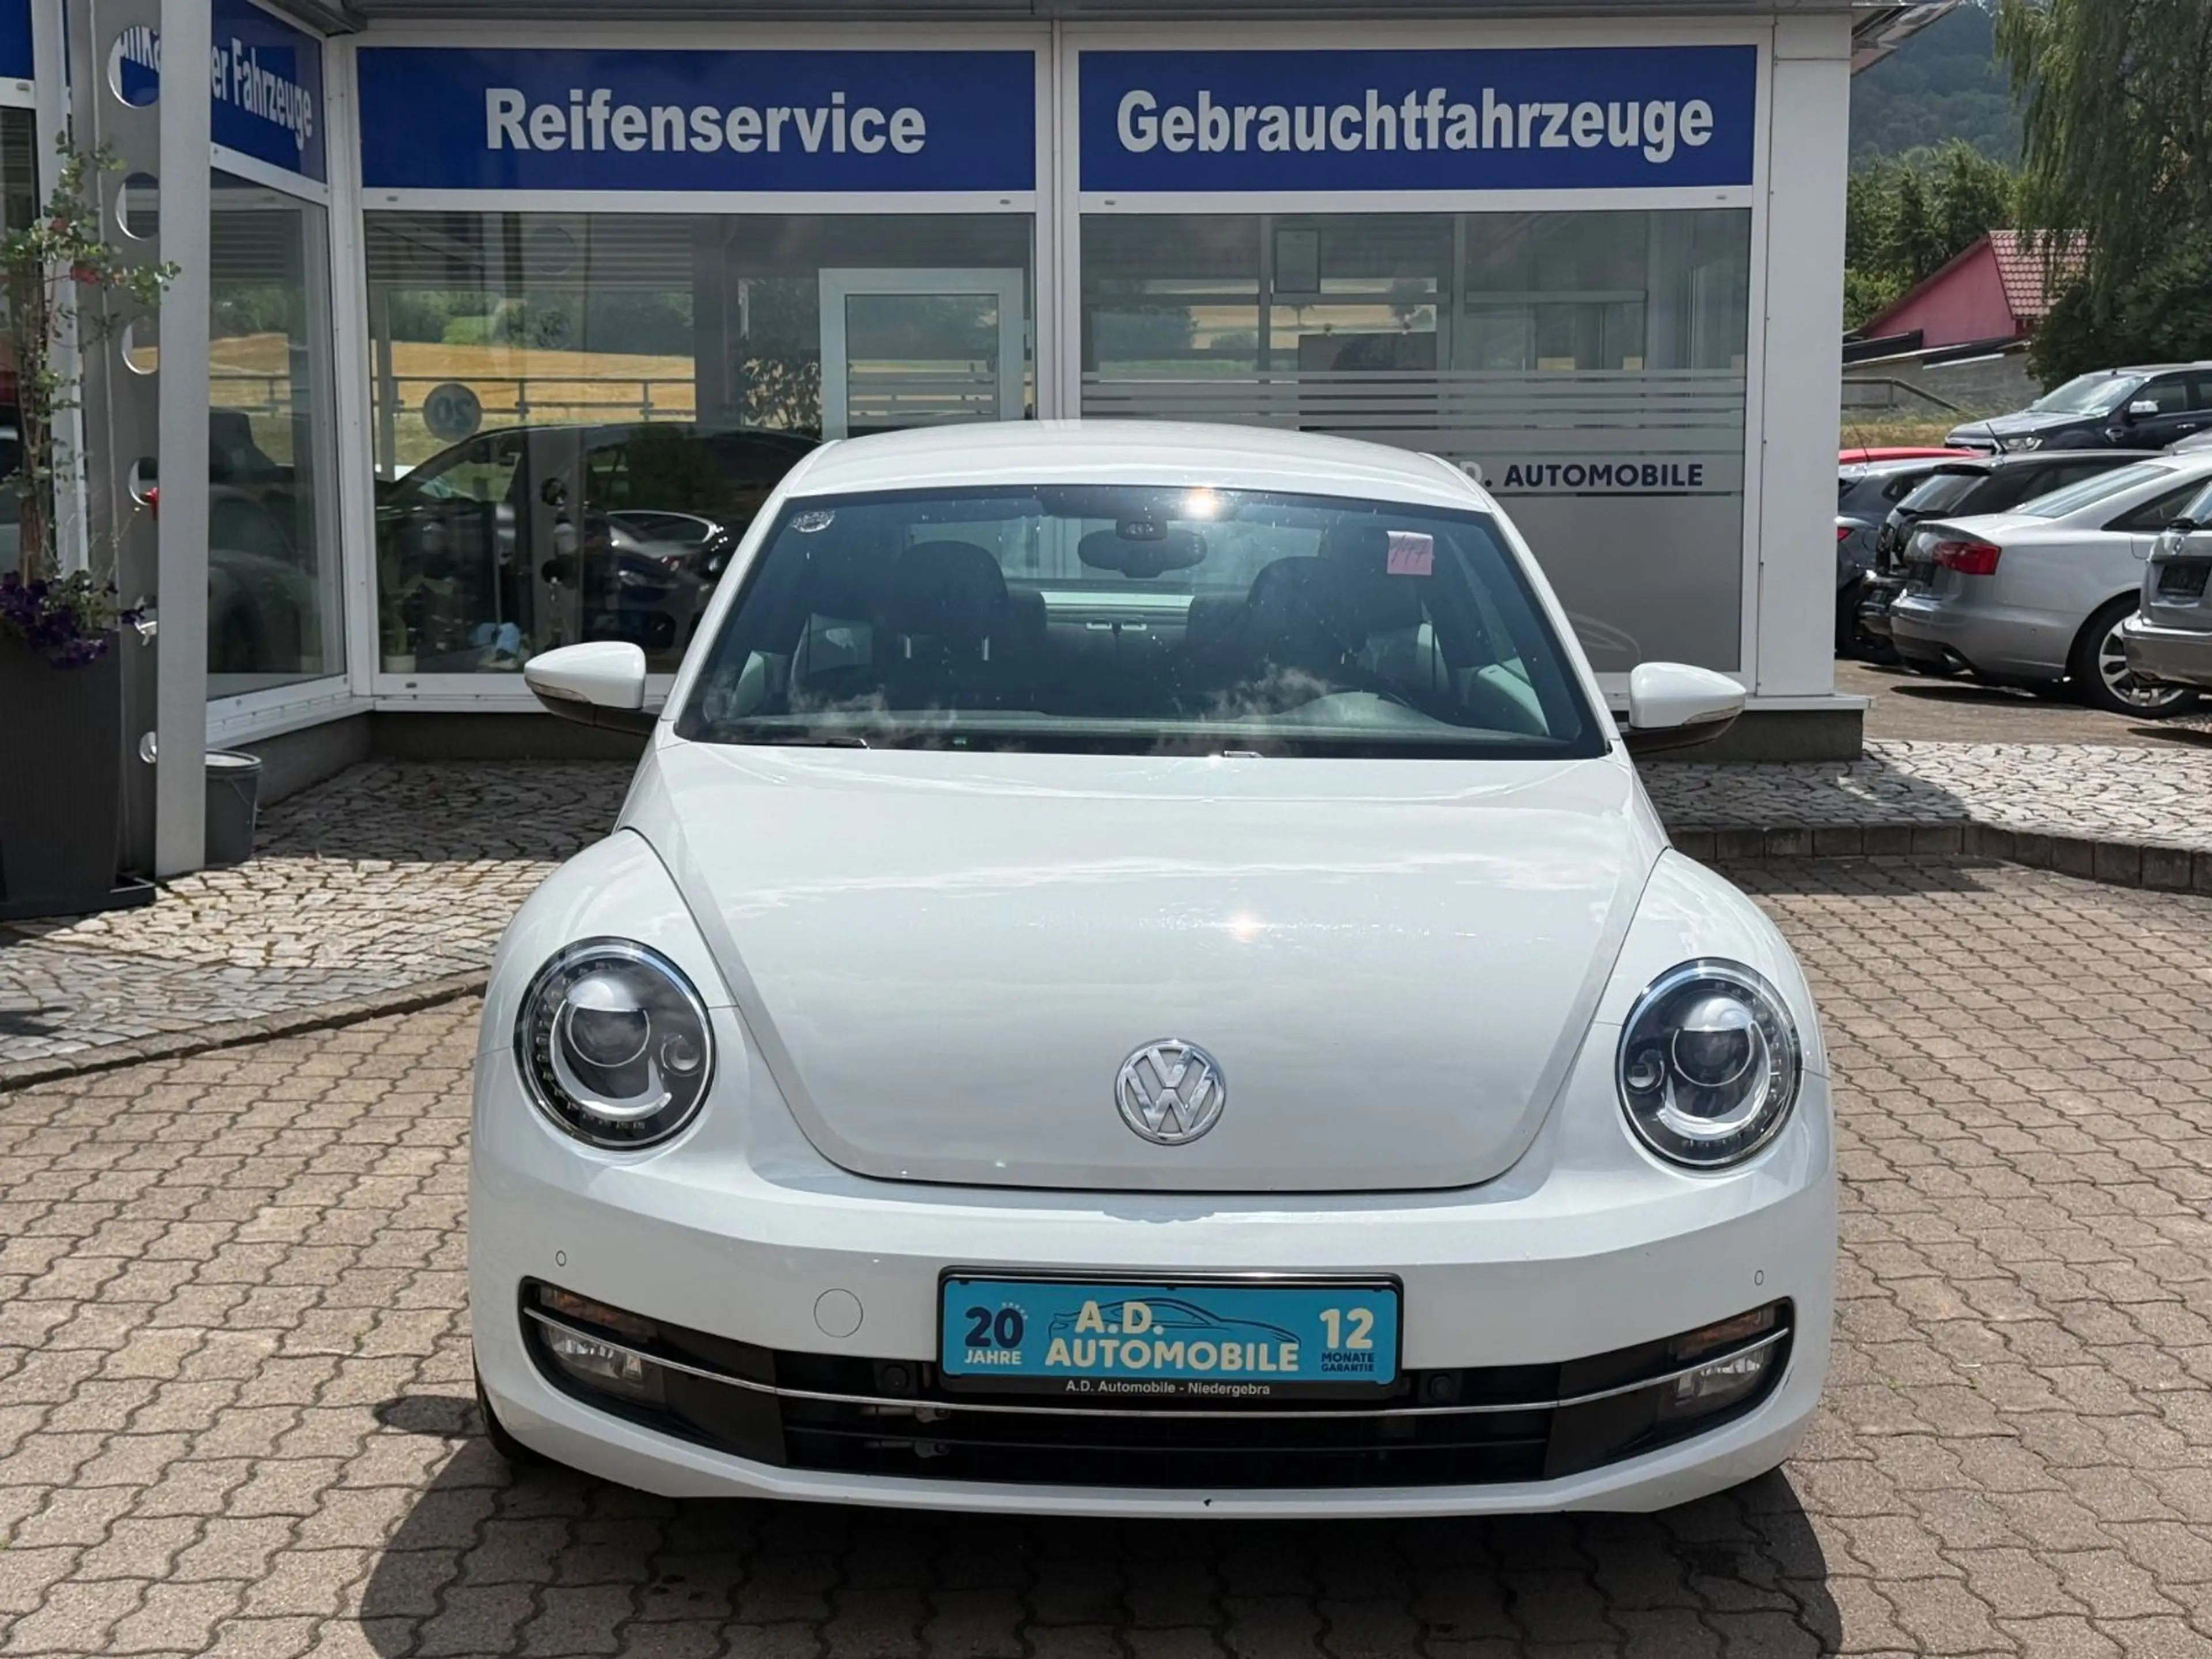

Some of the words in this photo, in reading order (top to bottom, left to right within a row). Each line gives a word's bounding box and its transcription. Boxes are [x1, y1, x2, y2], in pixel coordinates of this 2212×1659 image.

[232, 37, 312, 151] Fahrzeuge
[485, 88, 926, 154] Reifenservice
[1116, 88, 1714, 164] Gebrauchtfahrzeuge
[1504, 464, 1703, 487] AUTOMOBILE
[964, 1307, 1024, 1349] 20
[1074, 1300, 1164, 1335] A.D.
[1319, 1308, 1374, 1350] 12
[963, 1349, 1022, 1366] JAHRE
[1044, 1338, 1300, 1373] AUTOMOBILE
[1321, 1352, 1374, 1363] MONATE
[1321, 1363, 1374, 1372] GARANTIE
[1066, 1380, 1094, 1392] A.D.
[1098, 1381, 1176, 1393] Automobile
[1188, 1382, 1270, 1398] Niedergebra
